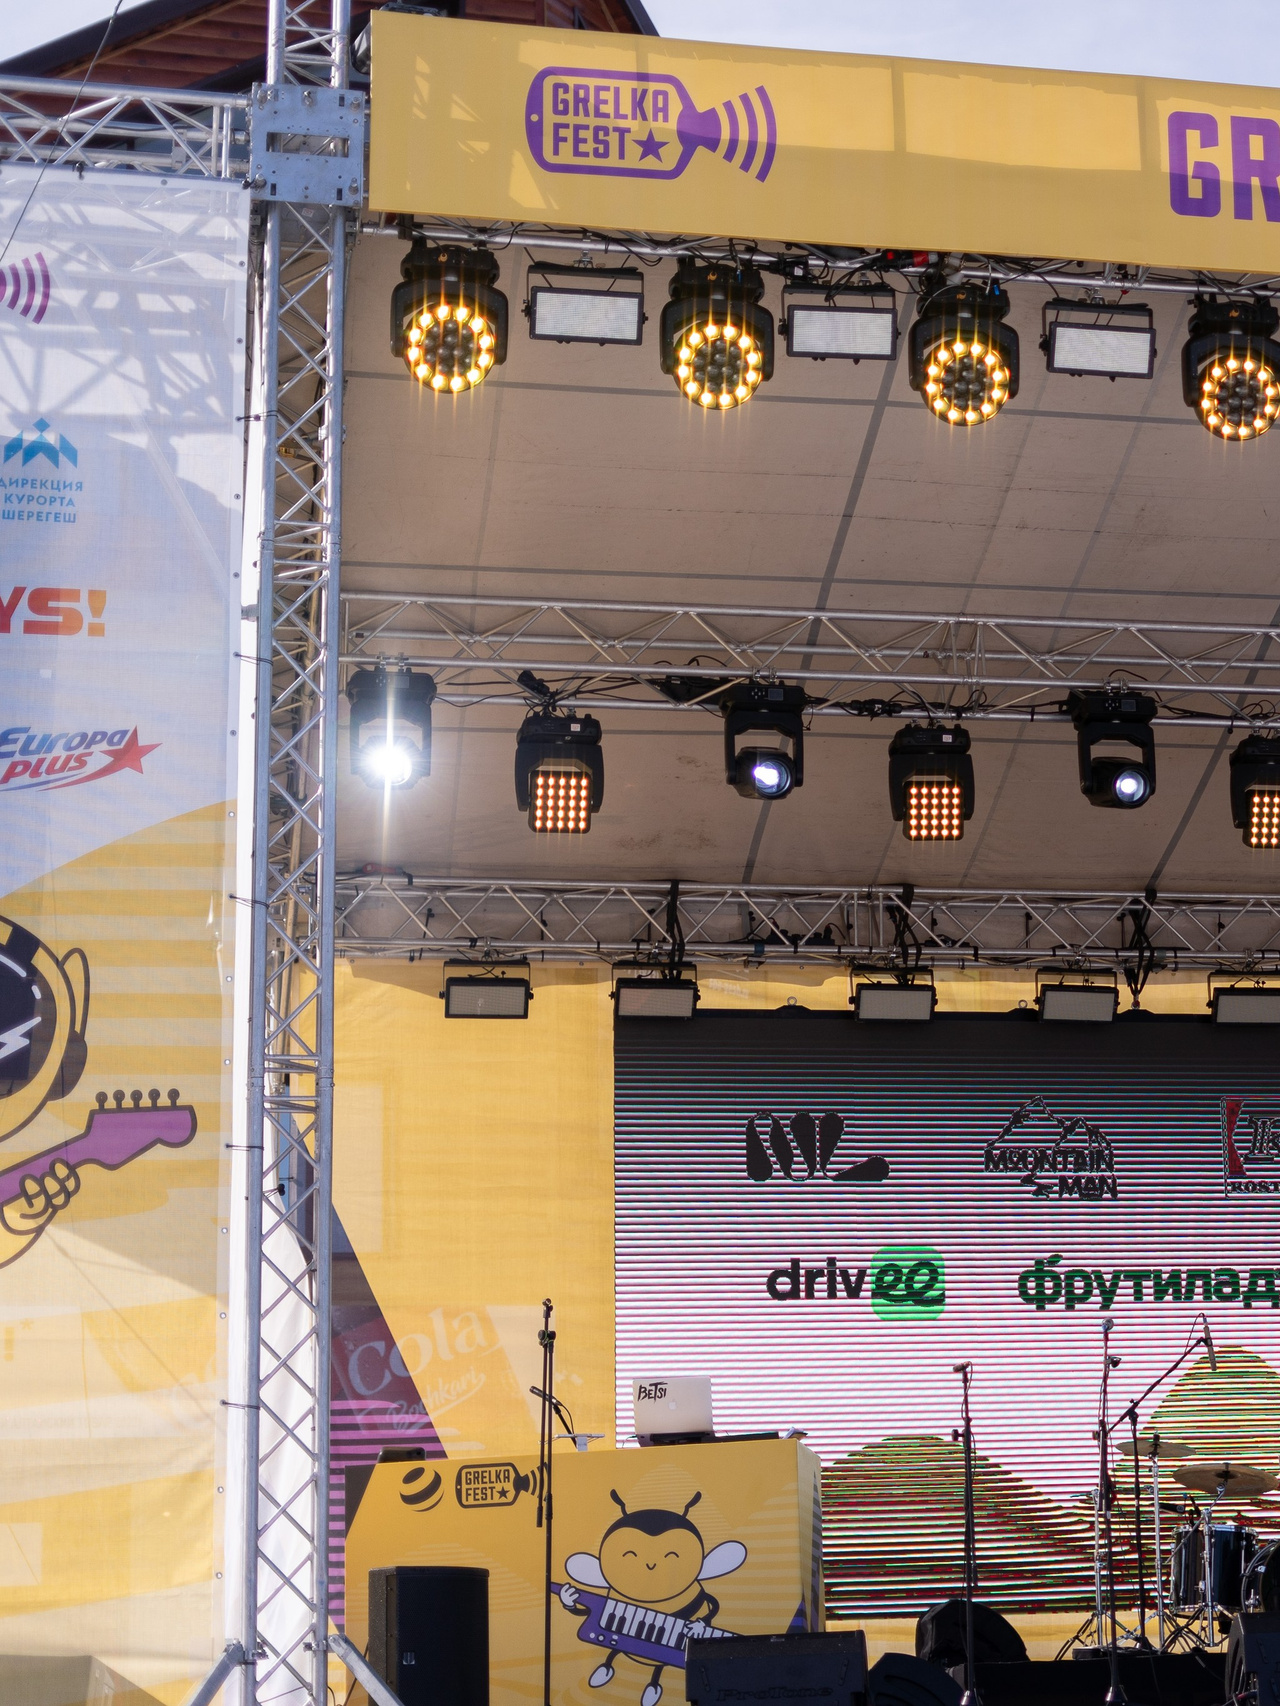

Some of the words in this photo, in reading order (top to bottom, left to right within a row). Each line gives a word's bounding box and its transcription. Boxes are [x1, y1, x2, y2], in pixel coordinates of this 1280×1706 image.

[552, 82, 669, 123] GRELKA
[552, 122, 631, 160] FEST
[4, 493, 76, 508] КУРОРТА
[2, 509, 77, 524] ШЕРЕГЕШ
[1058, 1174, 1119, 1200] MAN
[348, 1306, 494, 1396] Cola
[465, 1469, 510, 1486] GRELKA
[465, 1486, 496, 1502] FEST
